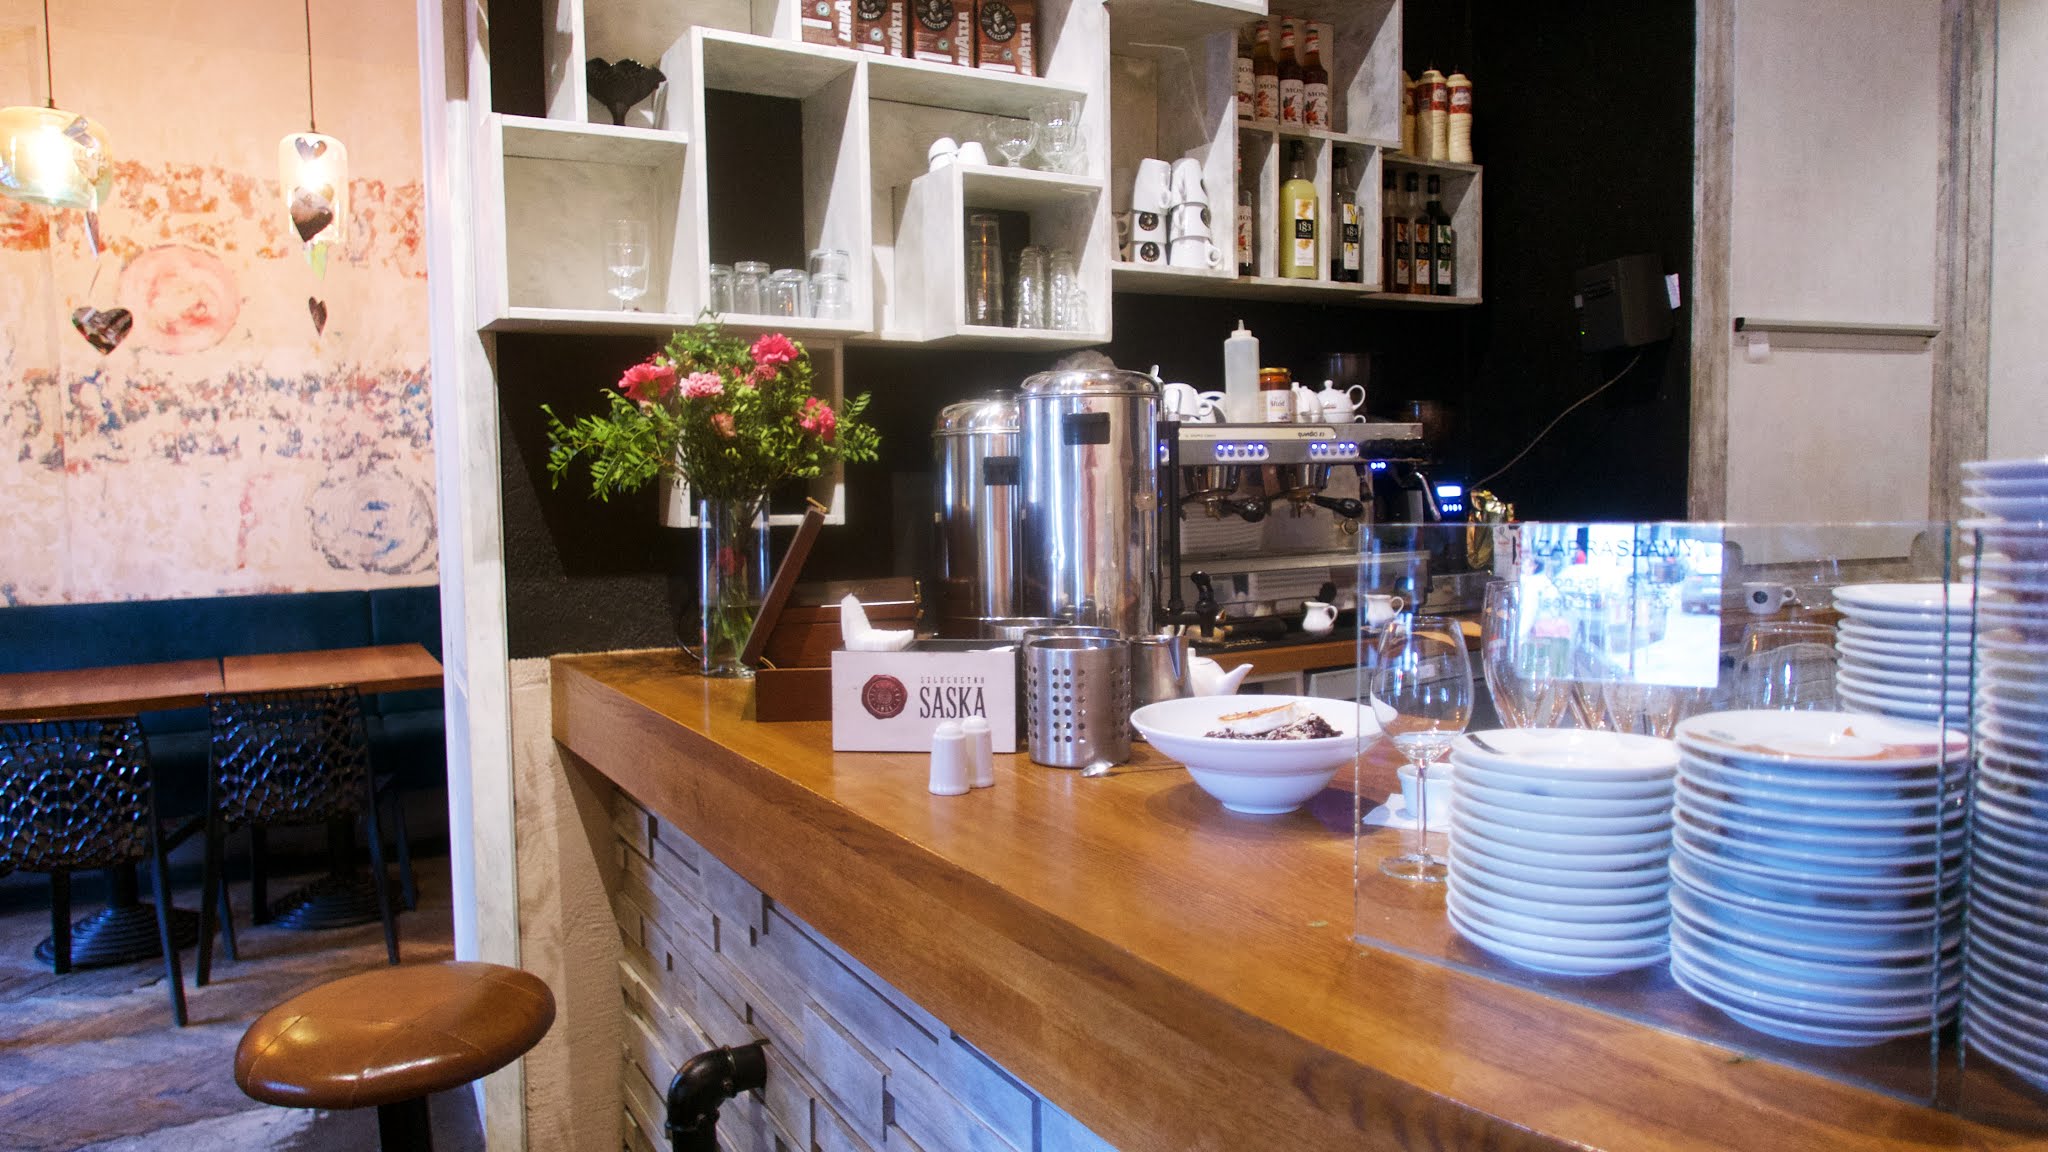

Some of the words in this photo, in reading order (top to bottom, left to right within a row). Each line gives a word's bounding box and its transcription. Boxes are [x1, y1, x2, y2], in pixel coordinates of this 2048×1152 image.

[888, 2, 902, 56] AVAZZA
[955, 12, 969, 66] AVAZZA
[1018, 23, 1031, 75] AVAZZA
[920, 686, 986, 718] SASKA
